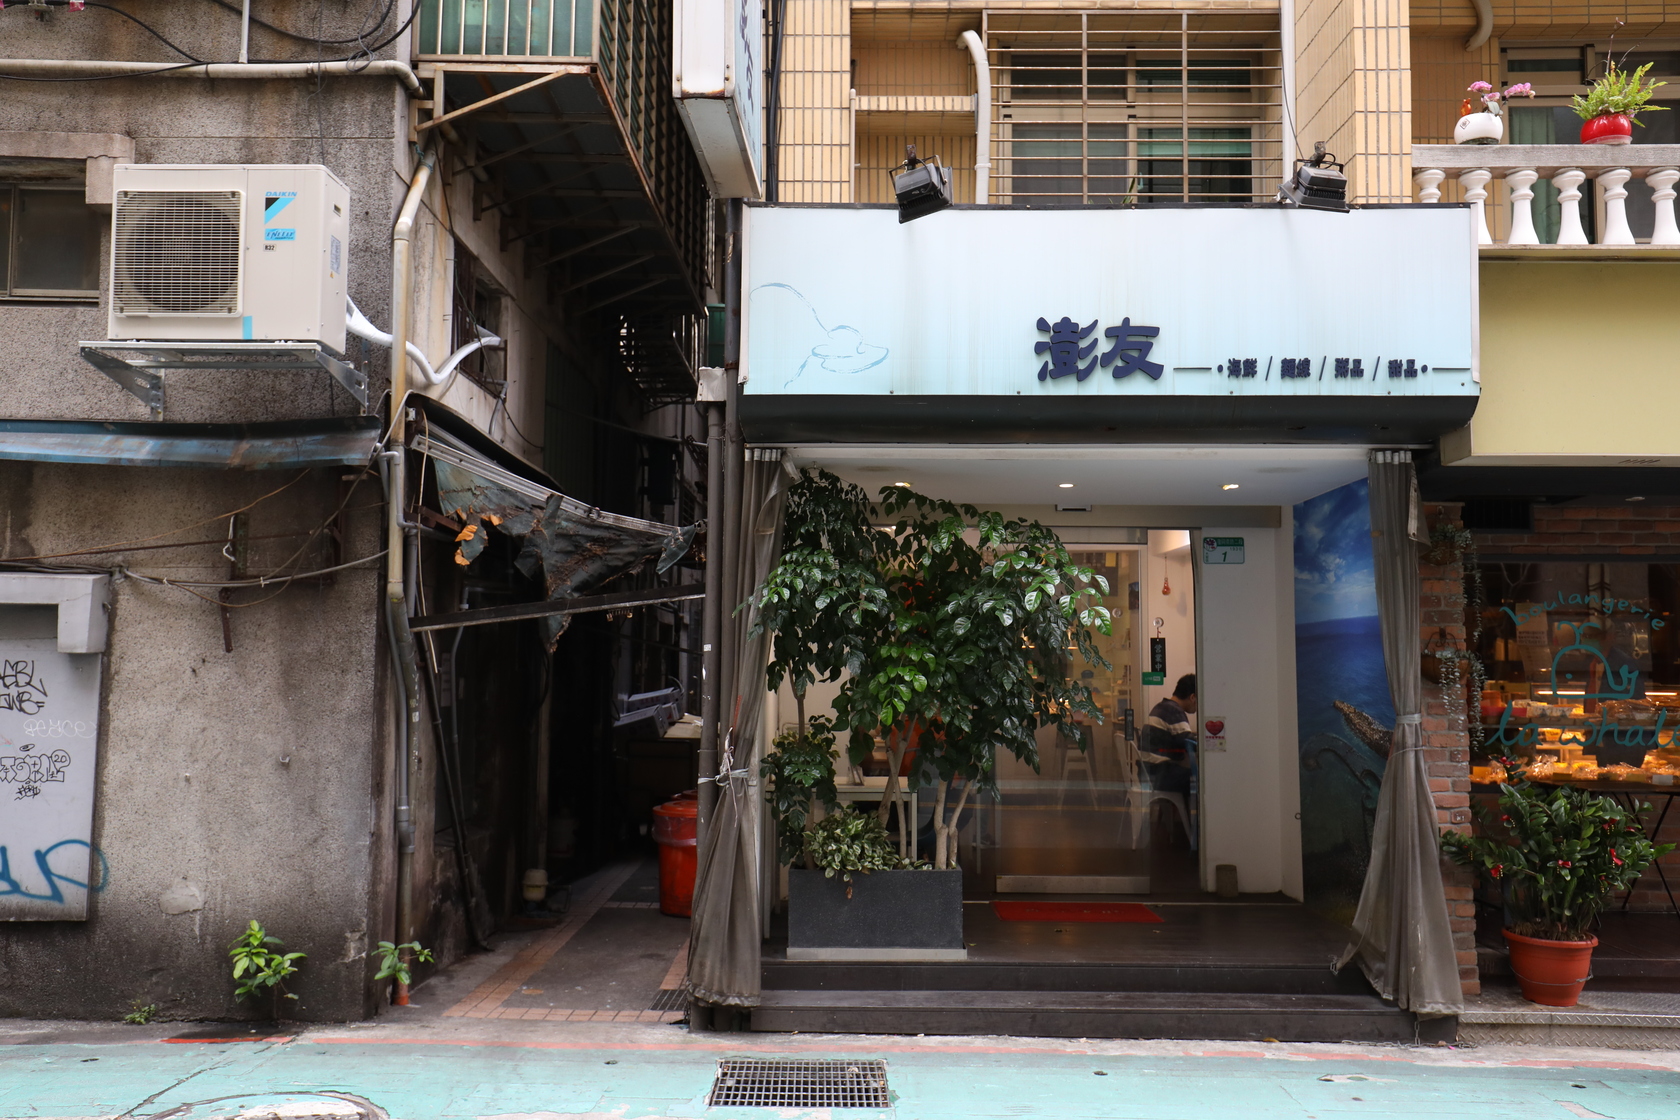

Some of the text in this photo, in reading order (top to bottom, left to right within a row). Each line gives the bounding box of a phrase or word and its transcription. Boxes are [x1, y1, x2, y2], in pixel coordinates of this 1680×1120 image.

[1034, 317, 1164, 381] 澎友
[1228, 358, 1257, 378] 海鮮
[1335, 358, 1364, 378] 粥品
[1388, 359, 1418, 378] 甜品
[1222, 551, 1228, 562] 1
[1500, 591, 1665, 630] boulangerie
[1484, 700, 1543, 746] la
